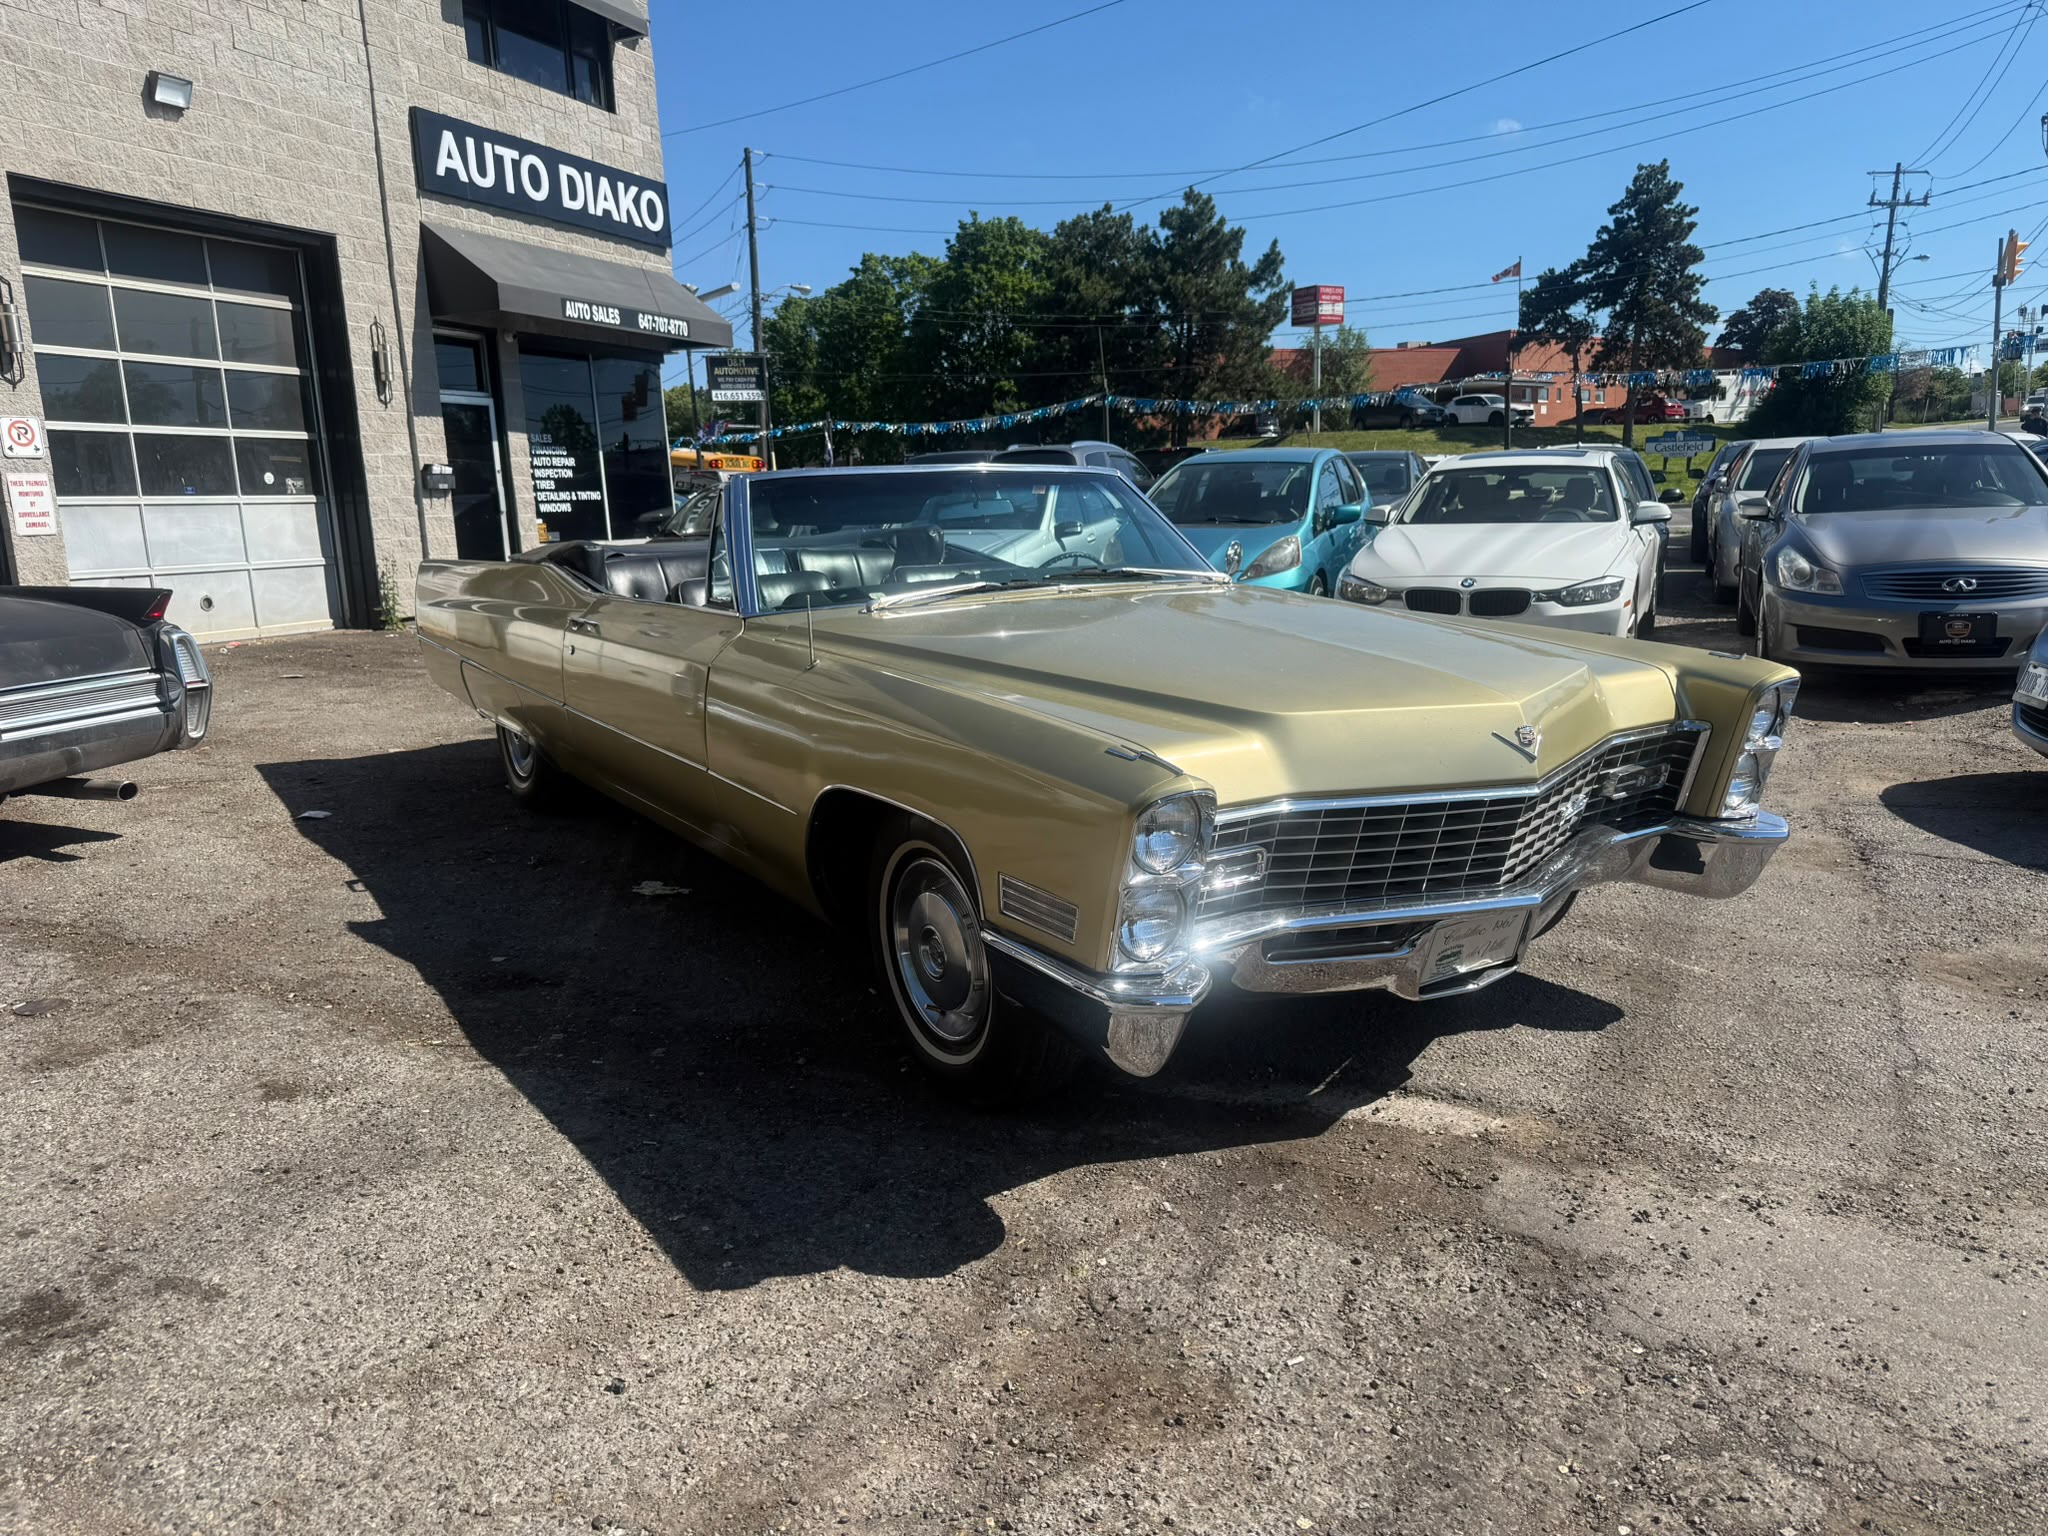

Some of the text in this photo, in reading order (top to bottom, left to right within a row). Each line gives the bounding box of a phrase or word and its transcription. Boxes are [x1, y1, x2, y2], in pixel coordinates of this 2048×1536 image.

[436, 130, 665, 233] AUTO DIAKO
[565, 300, 621, 326] AUTO SALES
[638, 315, 689, 337] 647-707-8770
[714, 367, 760, 375] AUTOMOTIVE
[530, 434, 553, 444] SALES
[532, 446, 567, 456] FINANCING
[1654, 441, 1704, 453] Castlefield
[533, 456, 576, 467] AUTO REPAIR
[534, 468, 573, 479] INSPECTION
[535, 480, 556, 490] TIRES
[537, 491, 602, 502] DETAILING & TINTING
[539, 502, 572, 513] WINDOWS
[25, 521, 47, 529] CAMERAS
